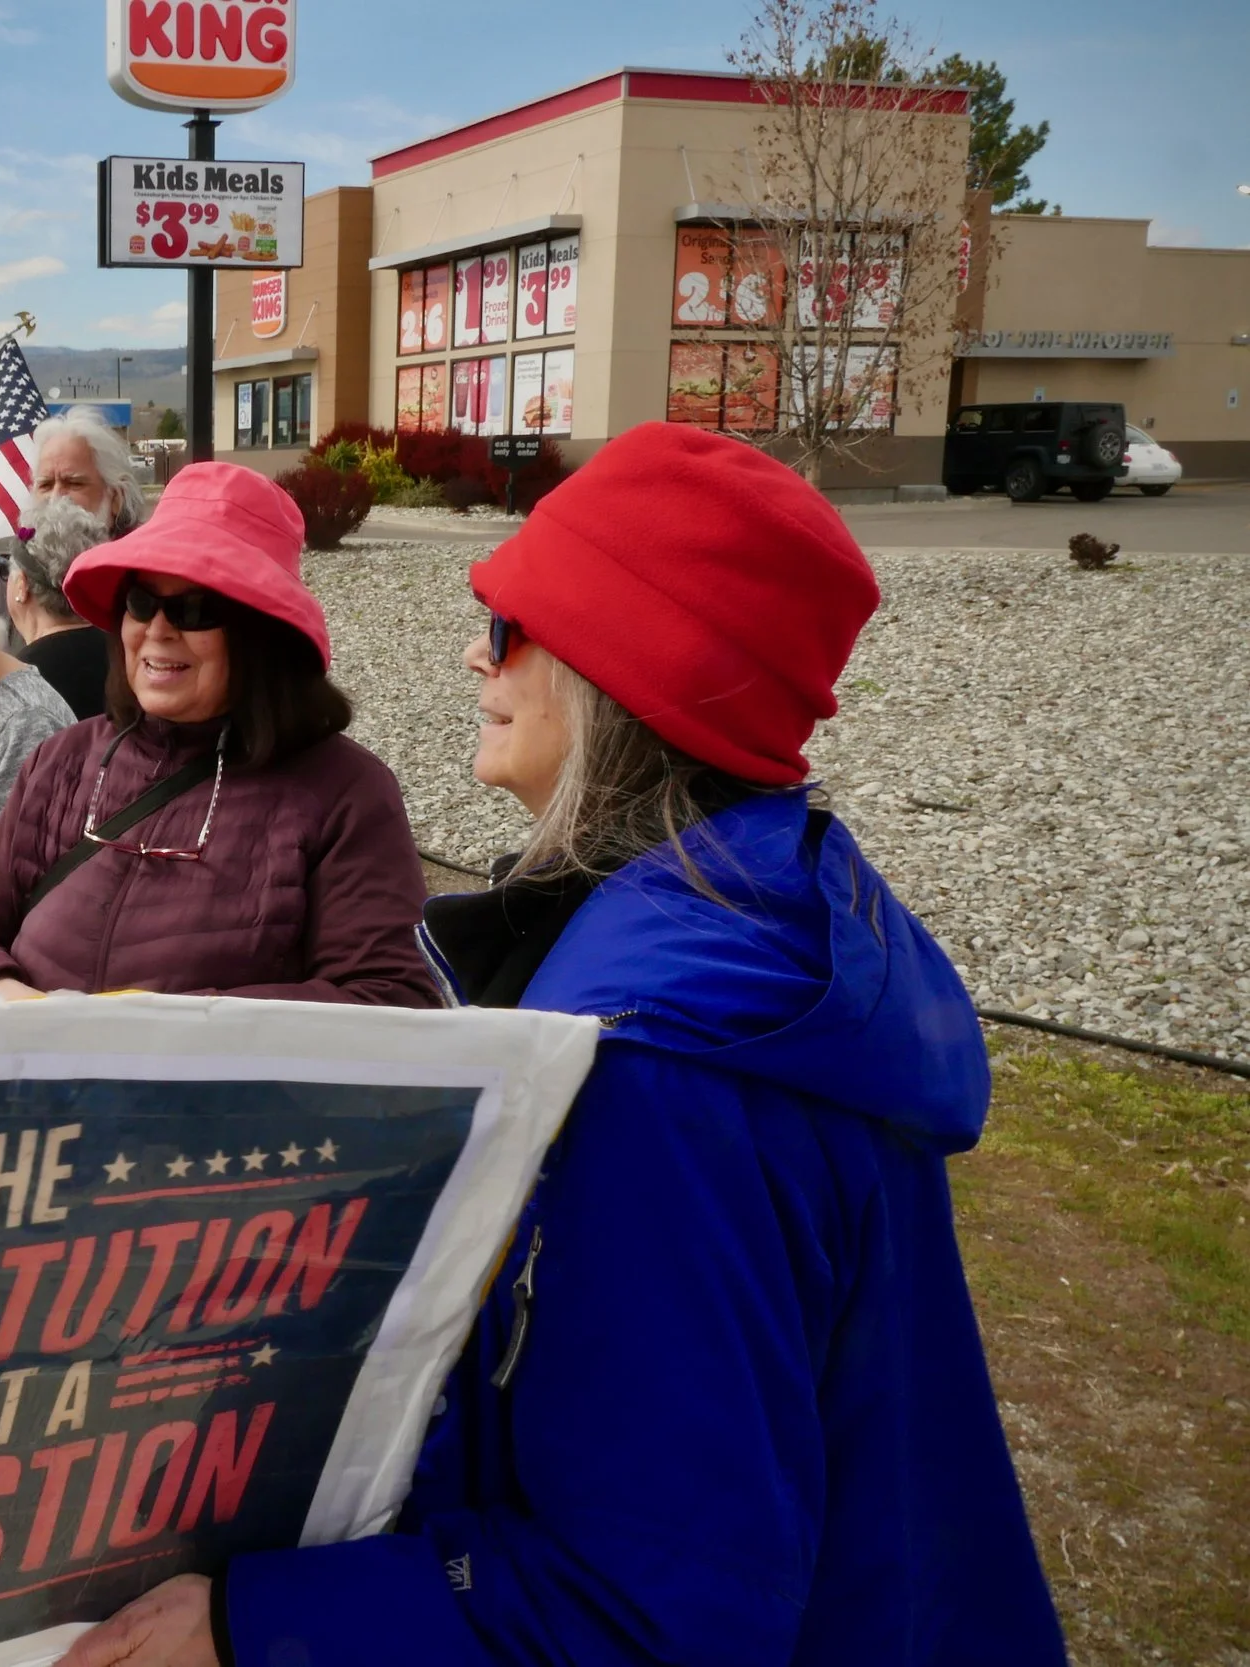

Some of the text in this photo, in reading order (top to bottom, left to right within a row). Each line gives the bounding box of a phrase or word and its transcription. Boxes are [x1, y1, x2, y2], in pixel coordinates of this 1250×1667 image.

[129, 2, 288, 63] KING
[133, 162, 284, 194] Kids Meals
[521, 252, 545, 270] Kids
[252, 295, 282, 321] KING
[1068, 331, 1173, 349] WHOPPER
[494, 449, 510, 457] only
[517, 449, 537, 457] enter
[45, 1359, 94, 1420] A
